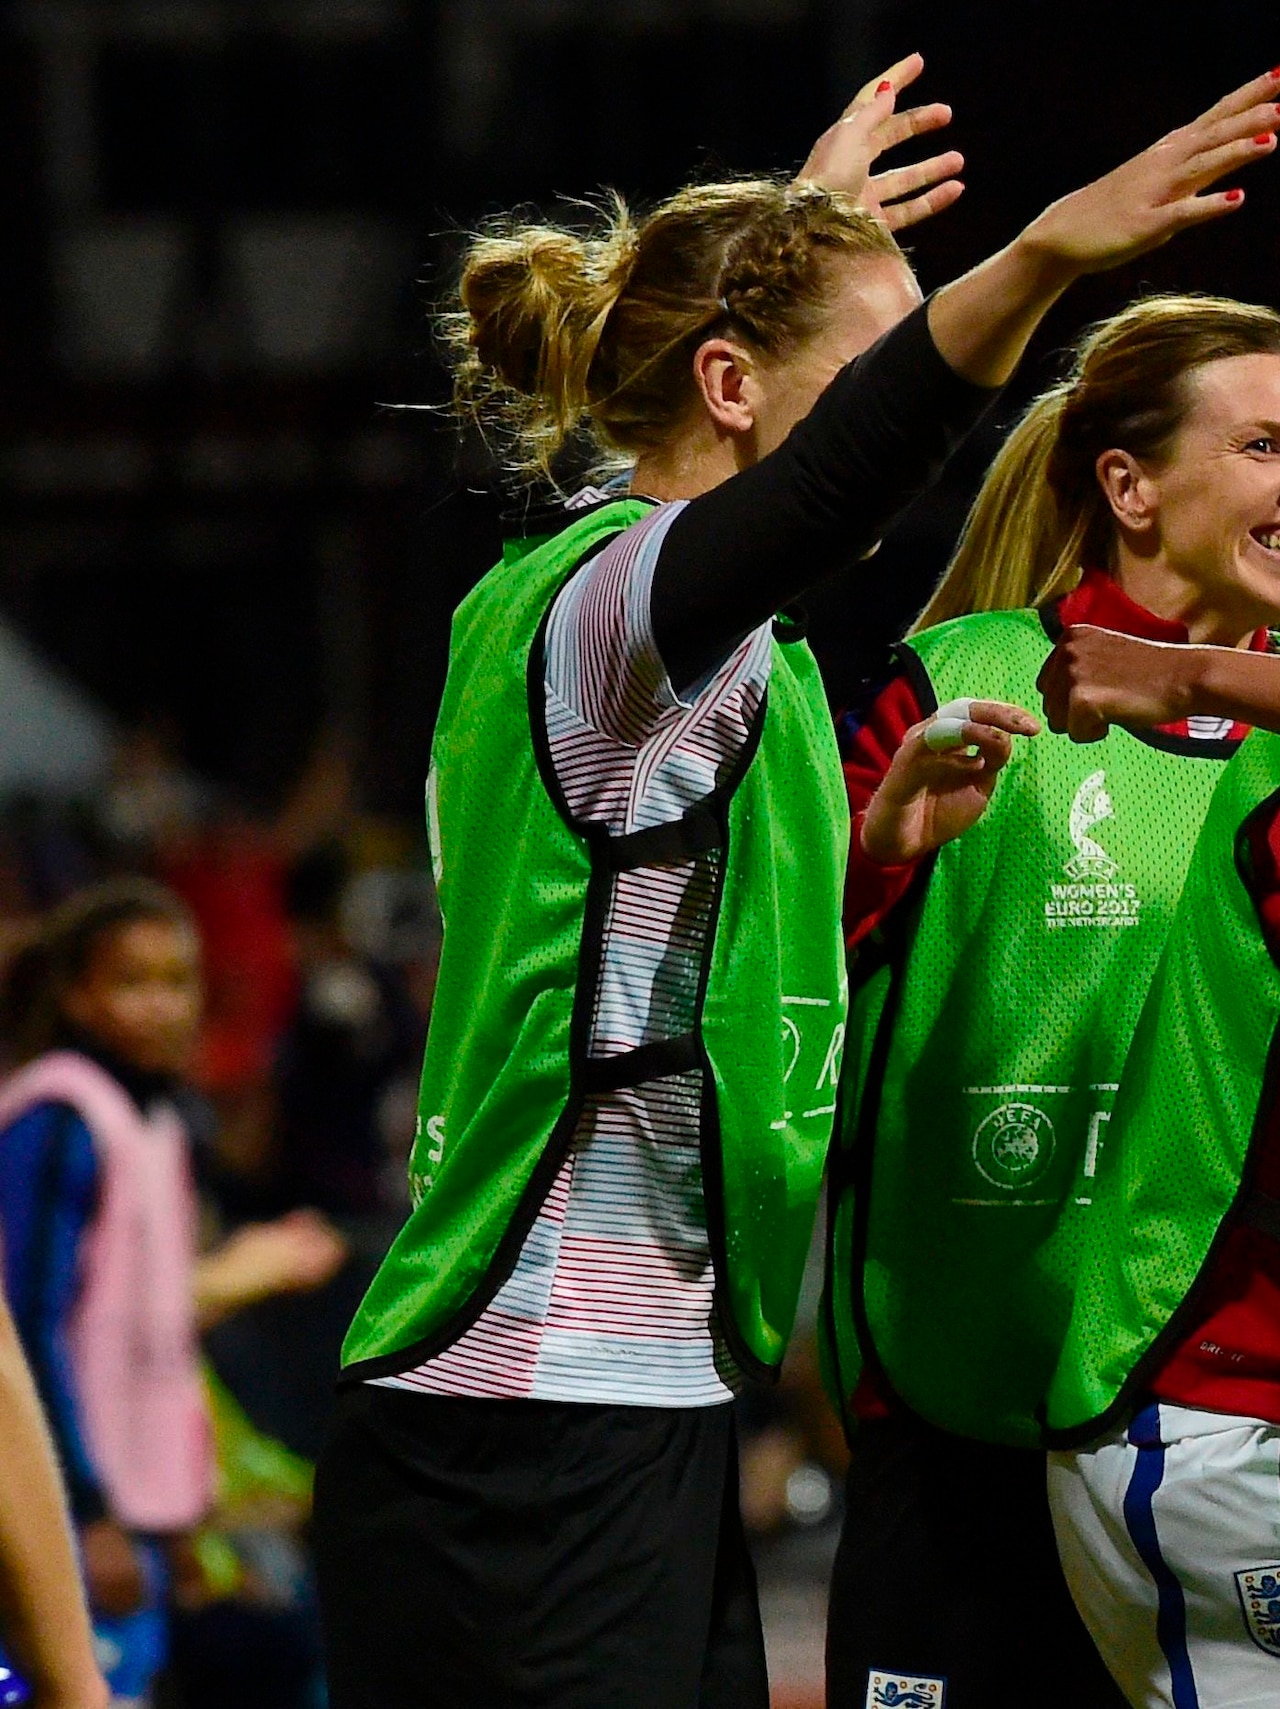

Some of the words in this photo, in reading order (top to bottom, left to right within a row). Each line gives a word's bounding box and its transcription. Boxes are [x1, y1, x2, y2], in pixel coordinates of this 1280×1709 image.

[1051, 884, 1136, 900] WOMEN'S
[1045, 901, 1094, 916] EURO
[1097, 900, 1140, 916] 2017
